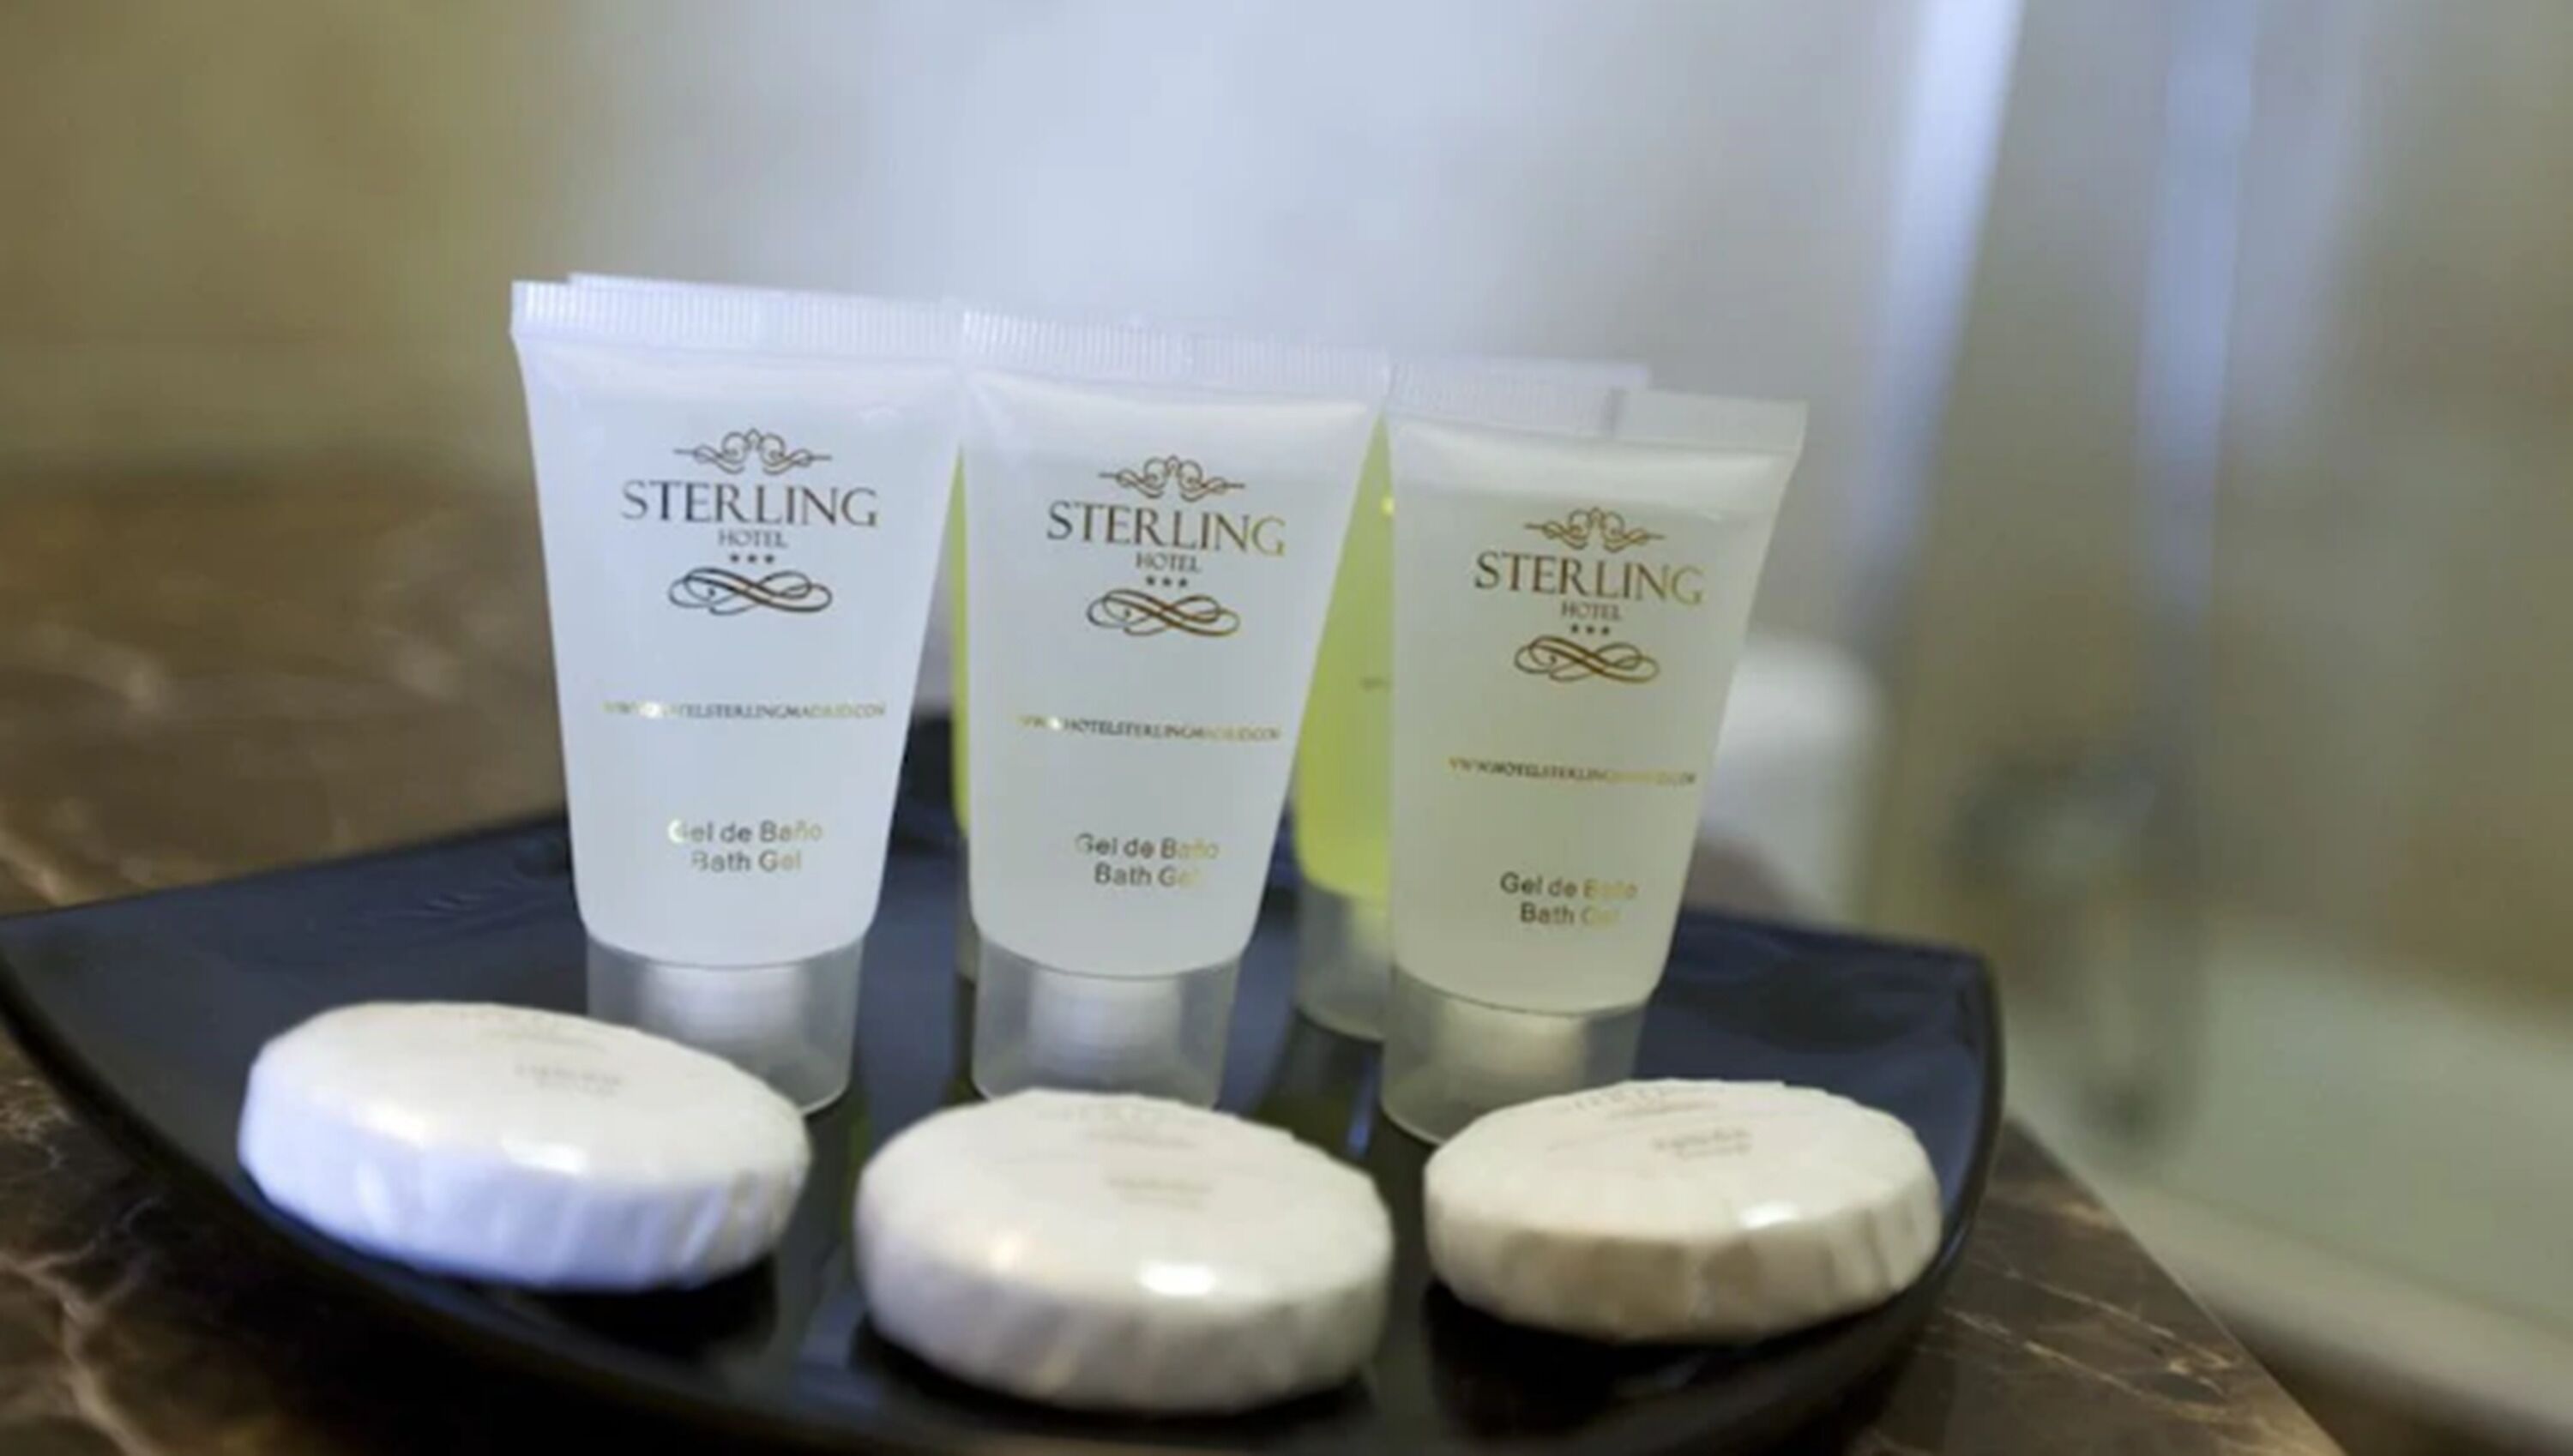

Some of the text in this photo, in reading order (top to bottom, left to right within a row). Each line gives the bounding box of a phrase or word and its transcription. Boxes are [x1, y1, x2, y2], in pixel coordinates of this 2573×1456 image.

[622, 479, 878, 527] STERLING
[719, 529, 788, 549] HOTEL
[1047, 501, 1285, 556] STERLING
[1136, 551, 1202, 574] HOTEL
[1474, 551, 1702, 605] STERLING
[1561, 600, 1624, 622] HOTEL
[669, 819, 823, 844] Gel de Baño
[1075, 833, 1118, 856] Gel
[1124, 837, 1155, 858] de
[691, 849, 802, 873] Bath Gel
[1094, 861, 1153, 887] Bath
[1500, 870, 1543, 894] Gel
[1547, 876, 1578, 898] de
[1520, 901, 1576, 924] Bath
